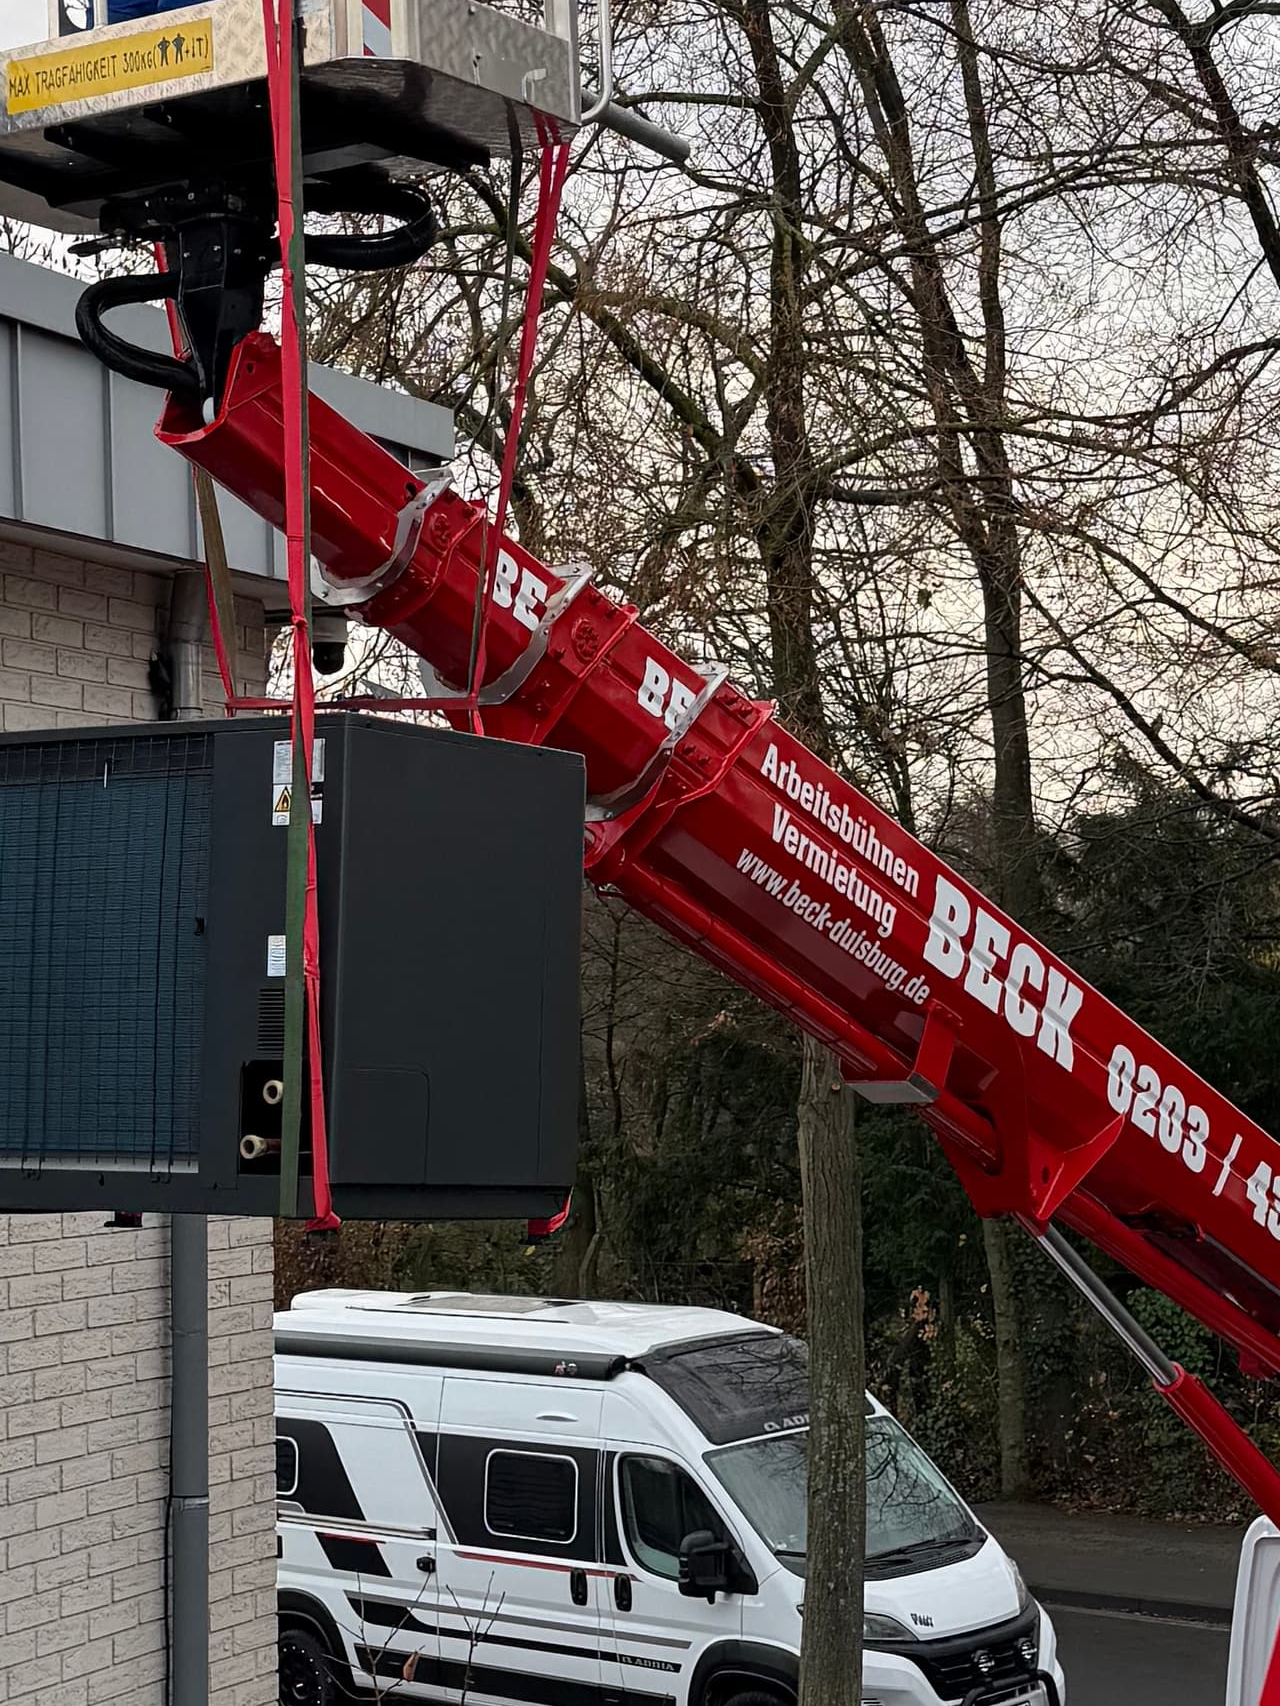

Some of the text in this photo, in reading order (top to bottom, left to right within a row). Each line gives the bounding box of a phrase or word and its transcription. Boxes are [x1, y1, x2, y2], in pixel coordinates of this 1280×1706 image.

[9, 74, 31, 98] MAX
[760, 743, 920, 898] Arbeitsbühnen
[772, 803, 897, 938] Vermietung
[736, 848, 931, 1005] www.beck-duisburg.de
[922, 873, 1084, 1073] BECK
[1107, 1044, 1210, 1173] 0203
